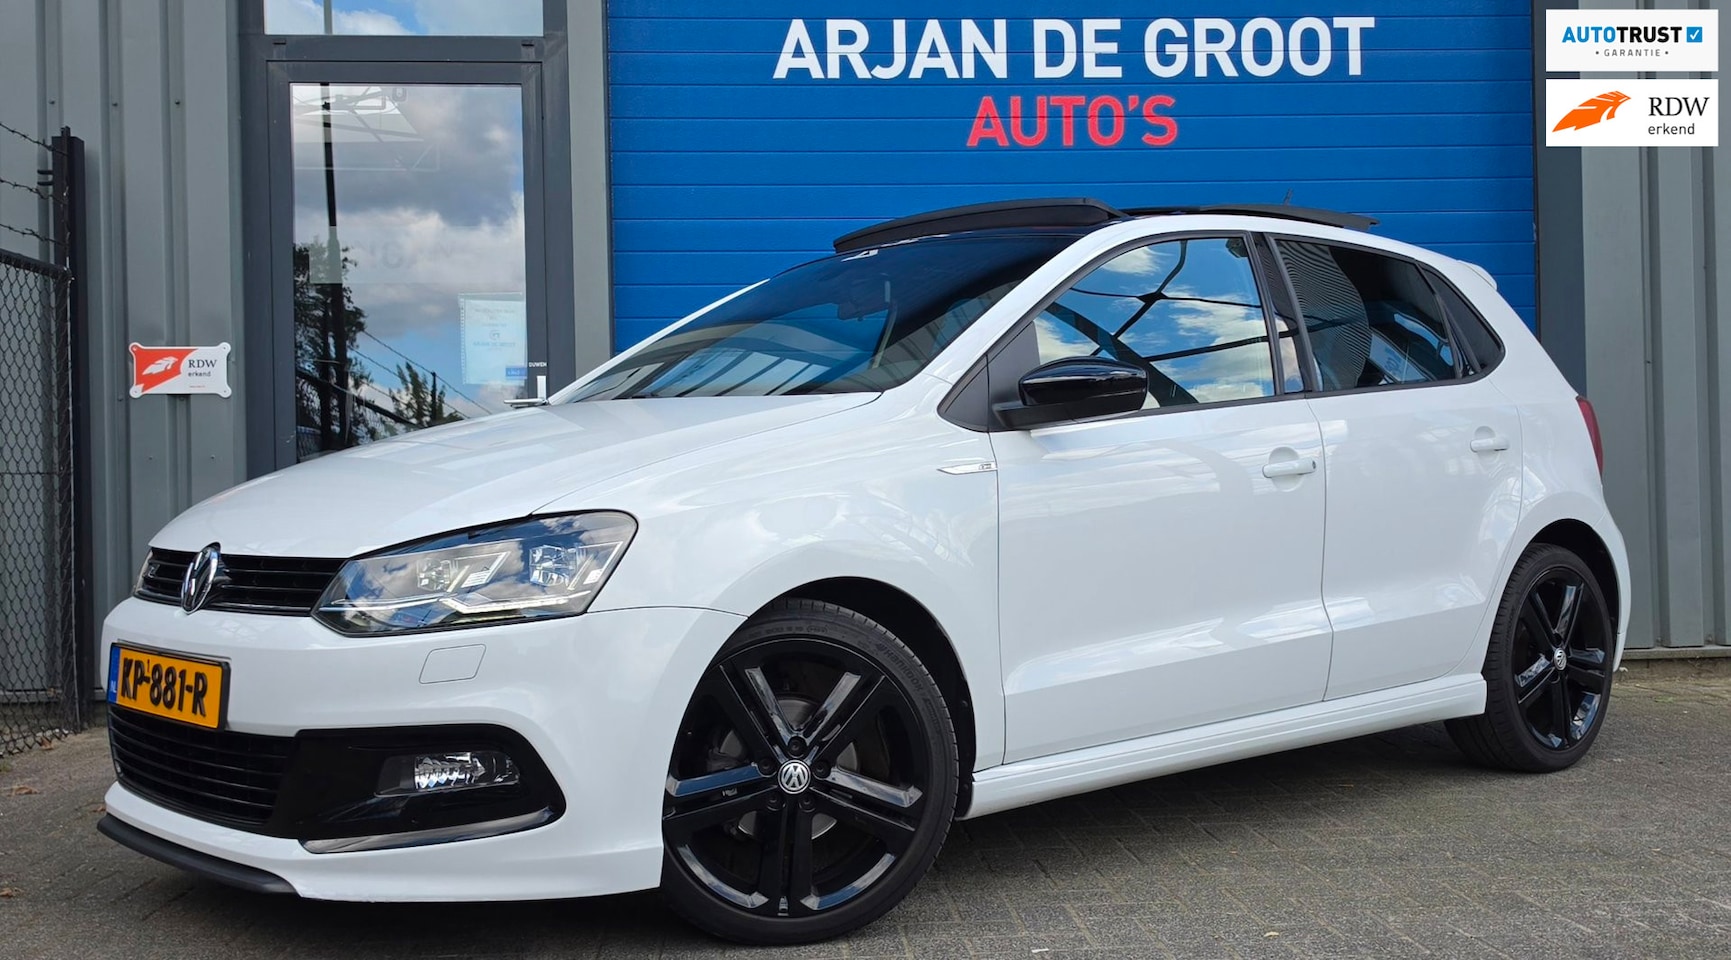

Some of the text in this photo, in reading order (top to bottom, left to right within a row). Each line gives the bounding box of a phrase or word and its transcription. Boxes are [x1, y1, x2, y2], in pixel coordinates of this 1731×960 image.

[773, 16, 1375, 80] ARJAN DE GROOT
[967, 94, 1178, 147] AUTO'S
[188, 359, 217, 369] RDW
[120, 656, 208, 718] KP-881-R
